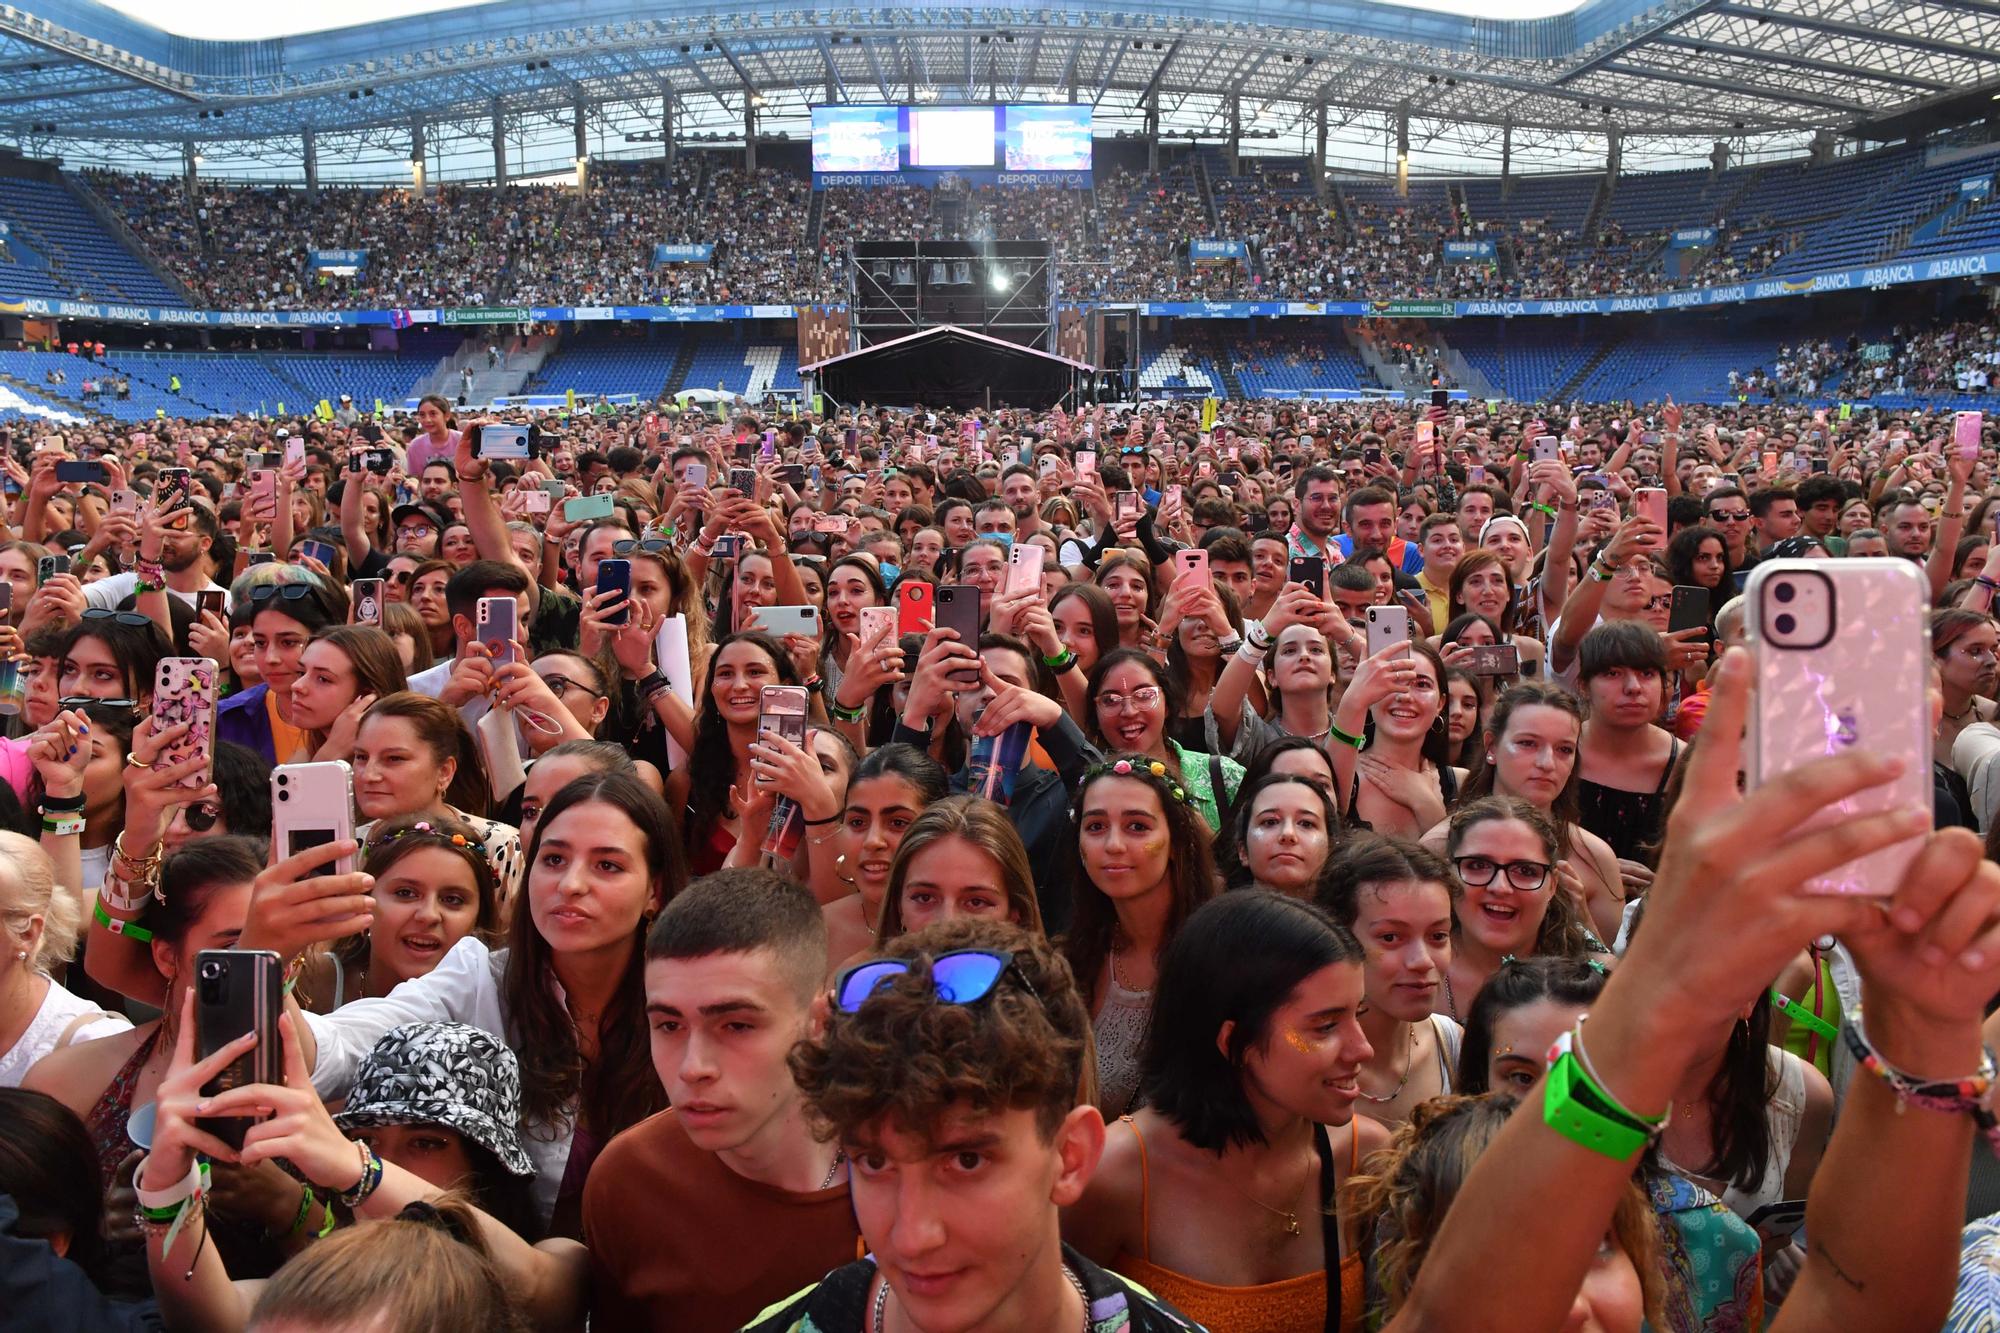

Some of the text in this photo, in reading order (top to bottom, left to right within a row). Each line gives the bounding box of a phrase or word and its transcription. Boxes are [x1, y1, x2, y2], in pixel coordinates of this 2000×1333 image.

[64, 303, 100, 317] ABANCA
[111, 305, 150, 320] ABANCA
[1472, 302, 1524, 314] ABANCA
[1546, 301, 1598, 313] ABANCA
[164, 309, 208, 322] ABANCA
[225, 312, 278, 324] ABANCA
[294, 311, 343, 323] ABANCA
